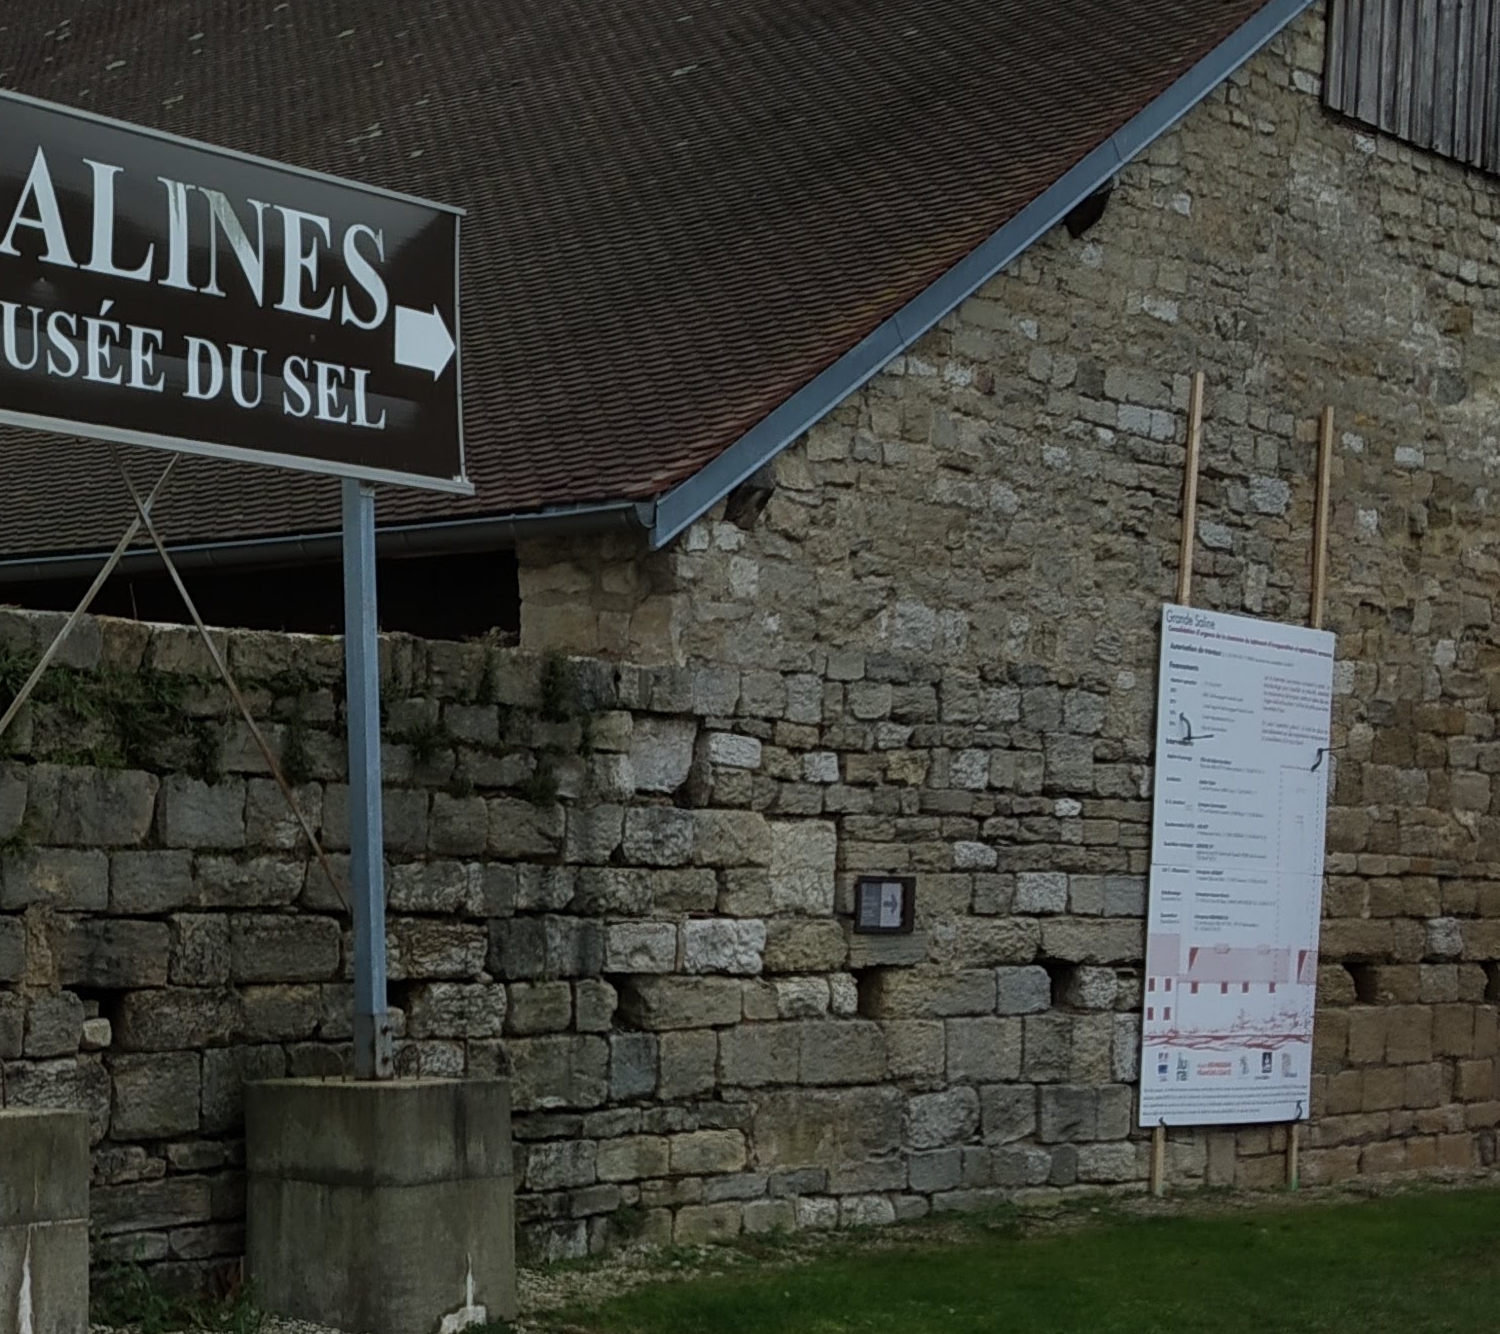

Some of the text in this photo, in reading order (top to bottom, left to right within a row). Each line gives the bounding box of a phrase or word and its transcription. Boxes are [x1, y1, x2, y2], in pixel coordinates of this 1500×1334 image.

[183, 334, 268, 410] DU
[283, 354, 387, 430] SEL
[1166, 609, 1216, 630] Grande Saline
